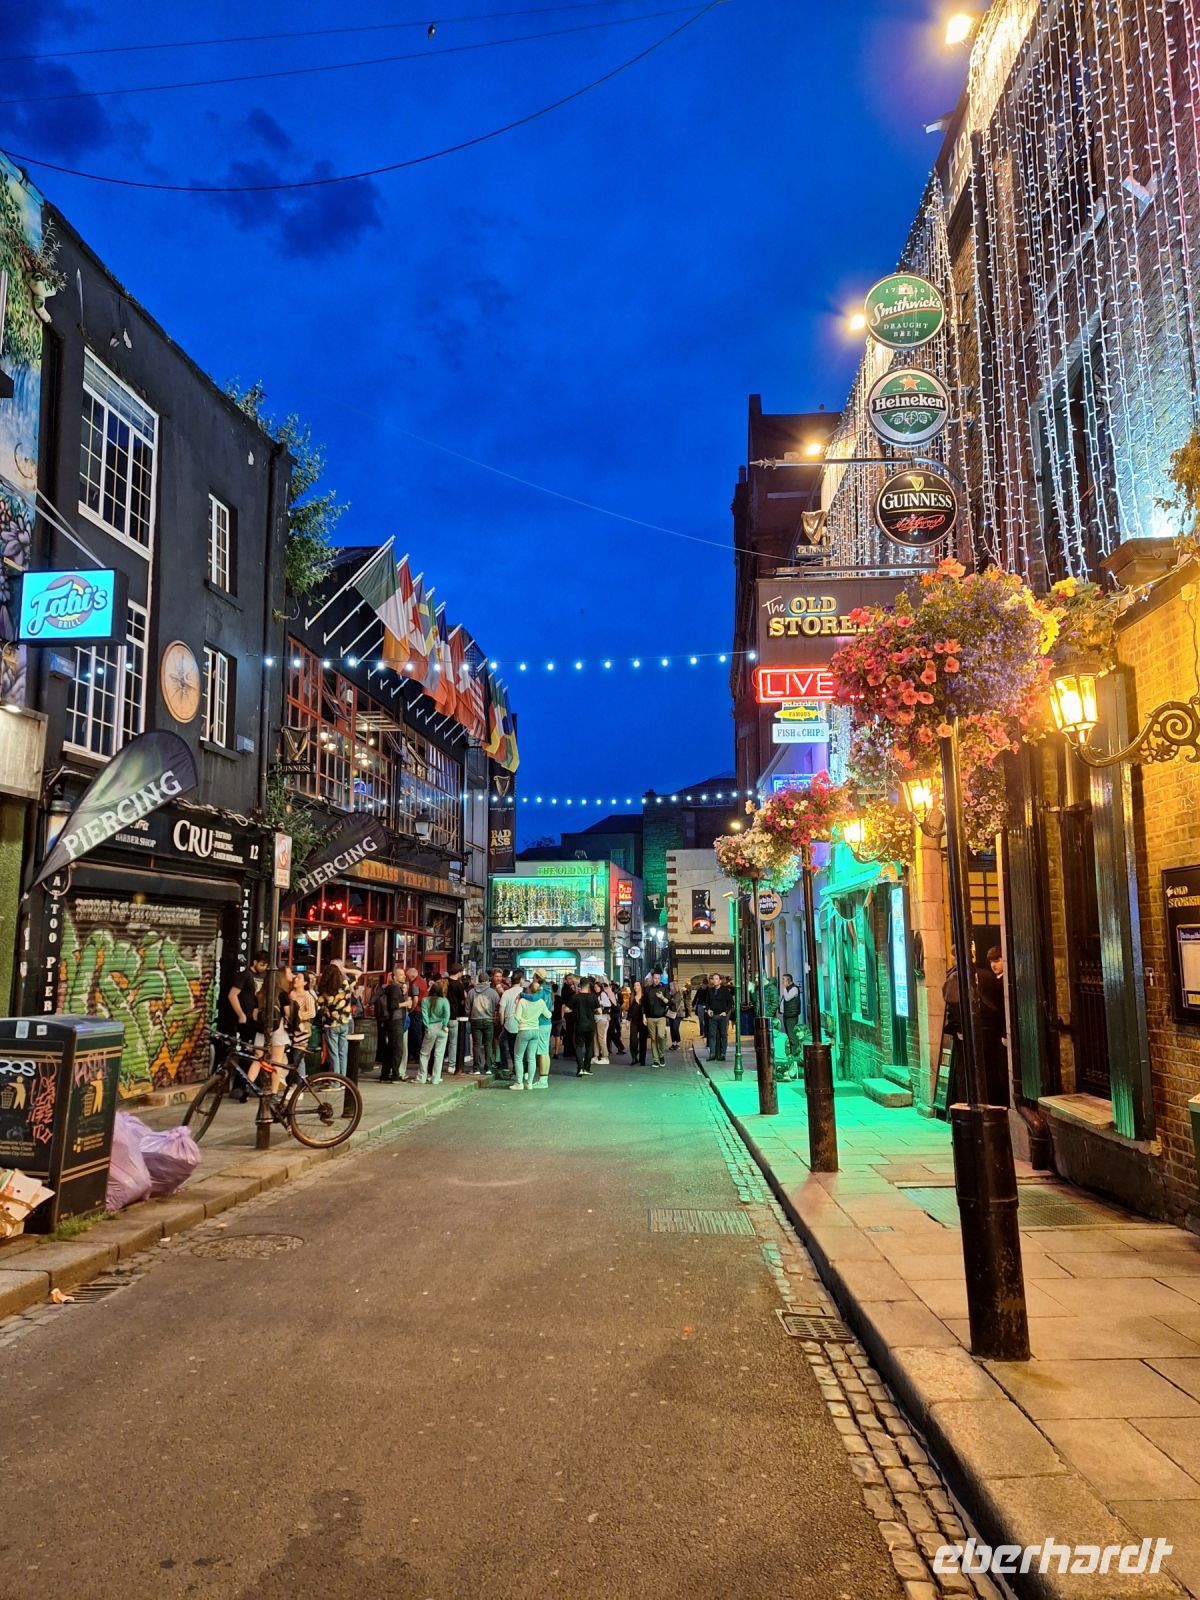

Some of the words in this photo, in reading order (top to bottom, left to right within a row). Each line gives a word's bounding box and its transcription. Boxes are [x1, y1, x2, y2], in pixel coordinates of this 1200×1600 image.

[870, 296, 941, 326] Smithwick's
[884, 322, 929, 330] DRAUGHT
[875, 394, 944, 411] Heineken
[881, 492, 954, 510] GUINNESS
[762, 596, 786, 615] The
[790, 596, 837, 614] OLD
[58, 619, 81, 628] GRILL
[768, 615, 874, 636] STORE
[767, 673, 834, 695] LIVE
[777, 729, 796, 737] FISH
[62, 770, 182, 860] PIERCING
[115, 833, 139, 845] BARBER
[139, 837, 157, 848] SHOP
[173, 819, 214, 857] CRU
[490, 837, 511, 847] ASS
[491, 829, 511, 838] BAD
[250, 845, 259, 860] 12
[299, 836, 378, 895] PIERCING
[557, 866, 577, 875] OLD
[361, 861, 399, 882] BADASS
[403, 871, 431, 889] TEMPLE
[434, 879, 449, 892] BAR
[1173, 886, 1188, 895] OLD
[49, 875, 61, 943] ATTOO
[240, 888, 250, 951] TATTOO
[494, 938, 512, 947] THE
[513, 938, 533, 947] OLD
[534, 938, 558, 946] MILL
